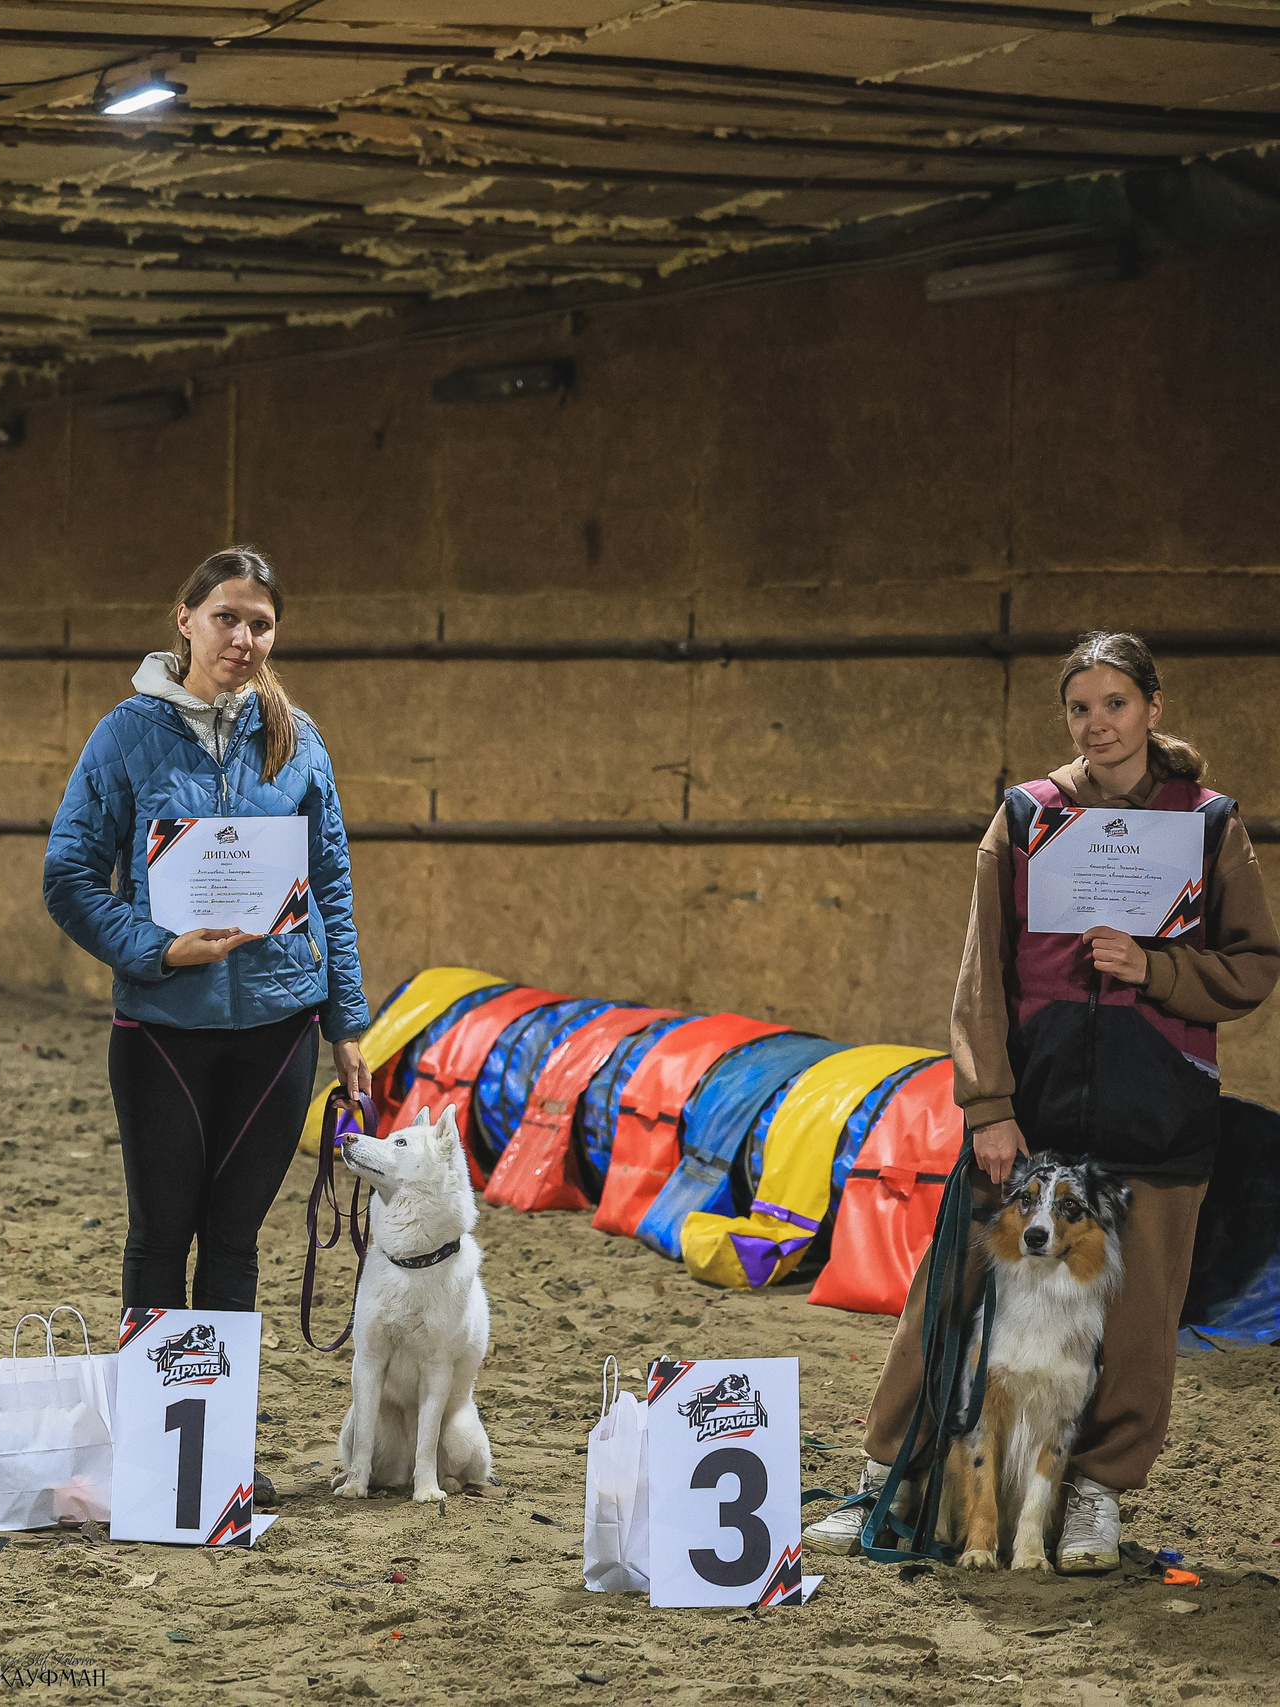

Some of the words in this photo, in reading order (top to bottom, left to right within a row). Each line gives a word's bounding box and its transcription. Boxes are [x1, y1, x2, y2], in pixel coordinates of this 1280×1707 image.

[202, 850, 251, 860] ДИПЛОМ
[1088, 843, 1140, 855] ДИПЛОМ
[165, 1360, 222, 1385] ДРАЙВ
[698, 1412, 760, 1441] ДРАЙВ
[165, 1398, 206, 1530] 1
[688, 1447, 771, 1587] 3
